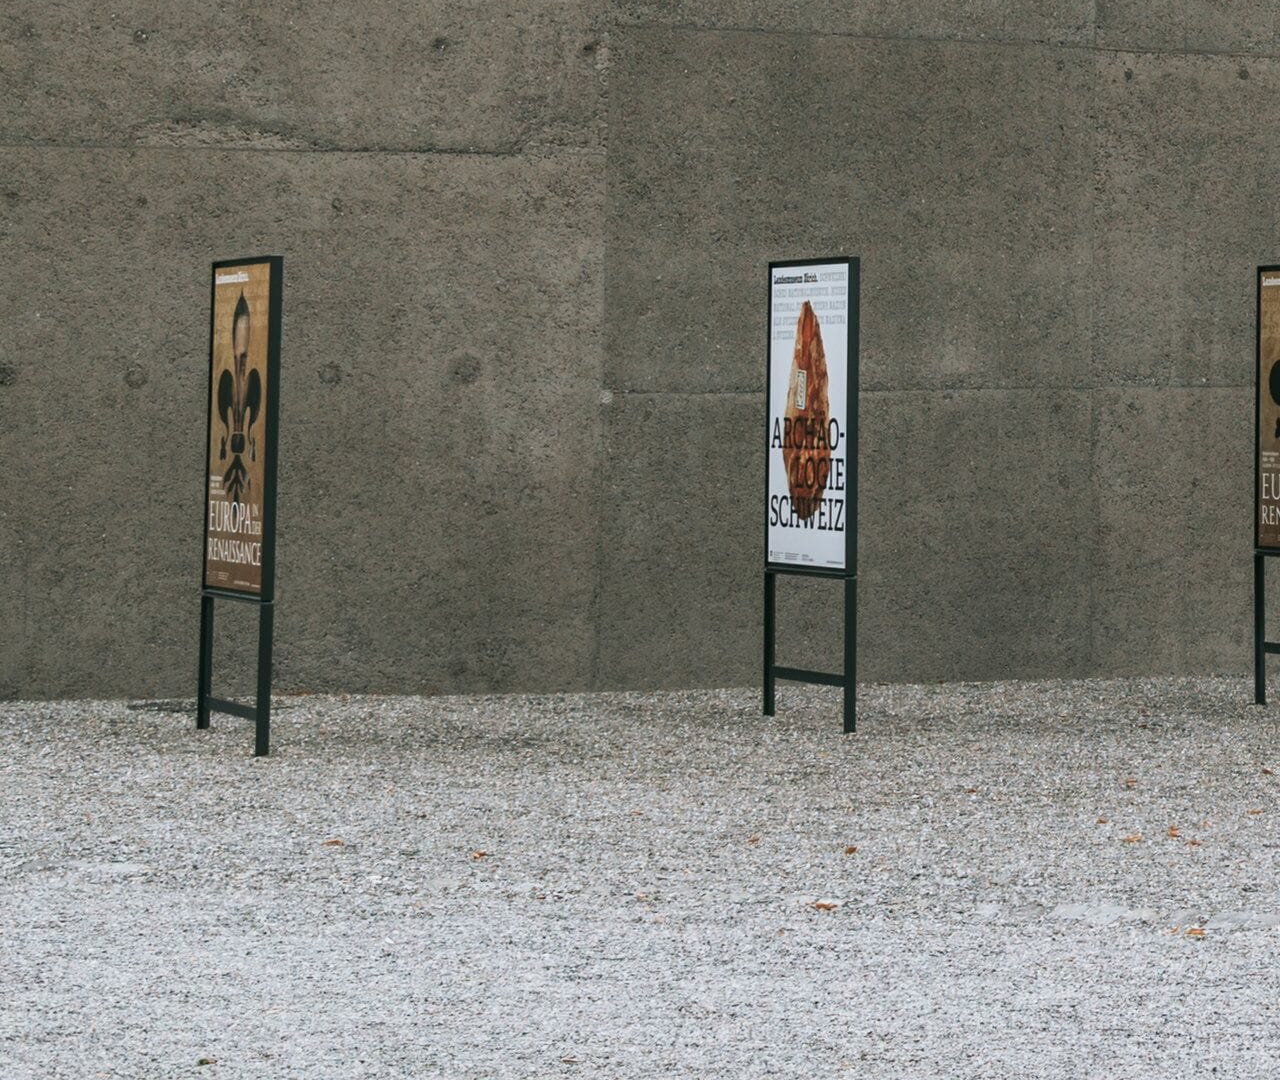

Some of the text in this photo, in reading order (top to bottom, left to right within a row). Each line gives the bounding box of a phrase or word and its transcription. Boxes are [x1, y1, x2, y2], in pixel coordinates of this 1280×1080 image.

[795, 458, 845, 491] LOGIE
[209, 501, 252, 534] EUROPA
[770, 495, 844, 532] SCHWEIZ
[208, 538, 262, 566] RENAISSANCE
